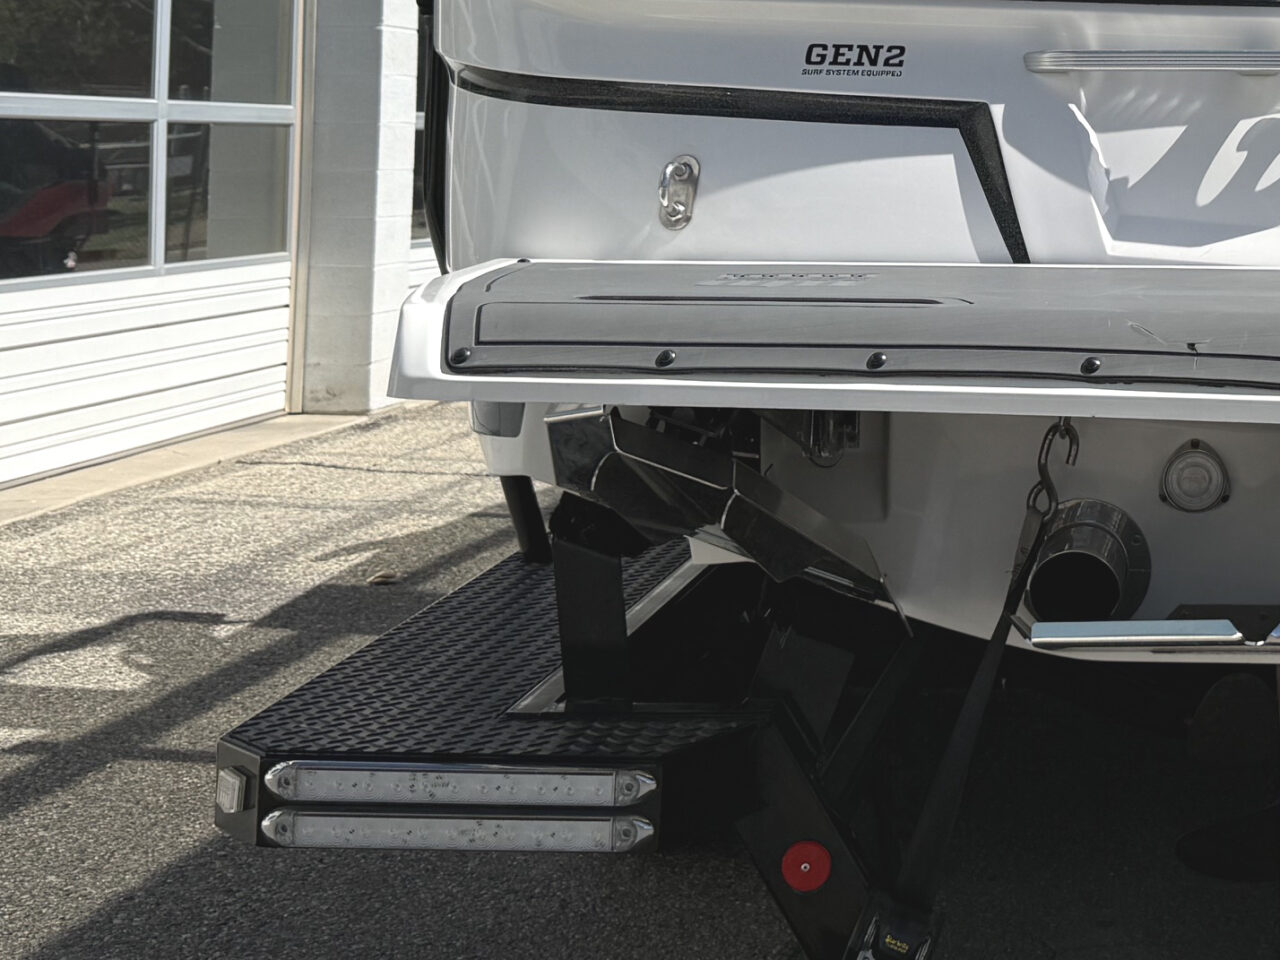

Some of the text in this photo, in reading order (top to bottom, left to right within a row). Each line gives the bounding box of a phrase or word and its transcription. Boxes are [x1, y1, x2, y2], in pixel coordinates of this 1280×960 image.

[804, 43, 907, 68] GEN2
[801, 68, 903, 78] SURF SYSTEM EQUIPPED
